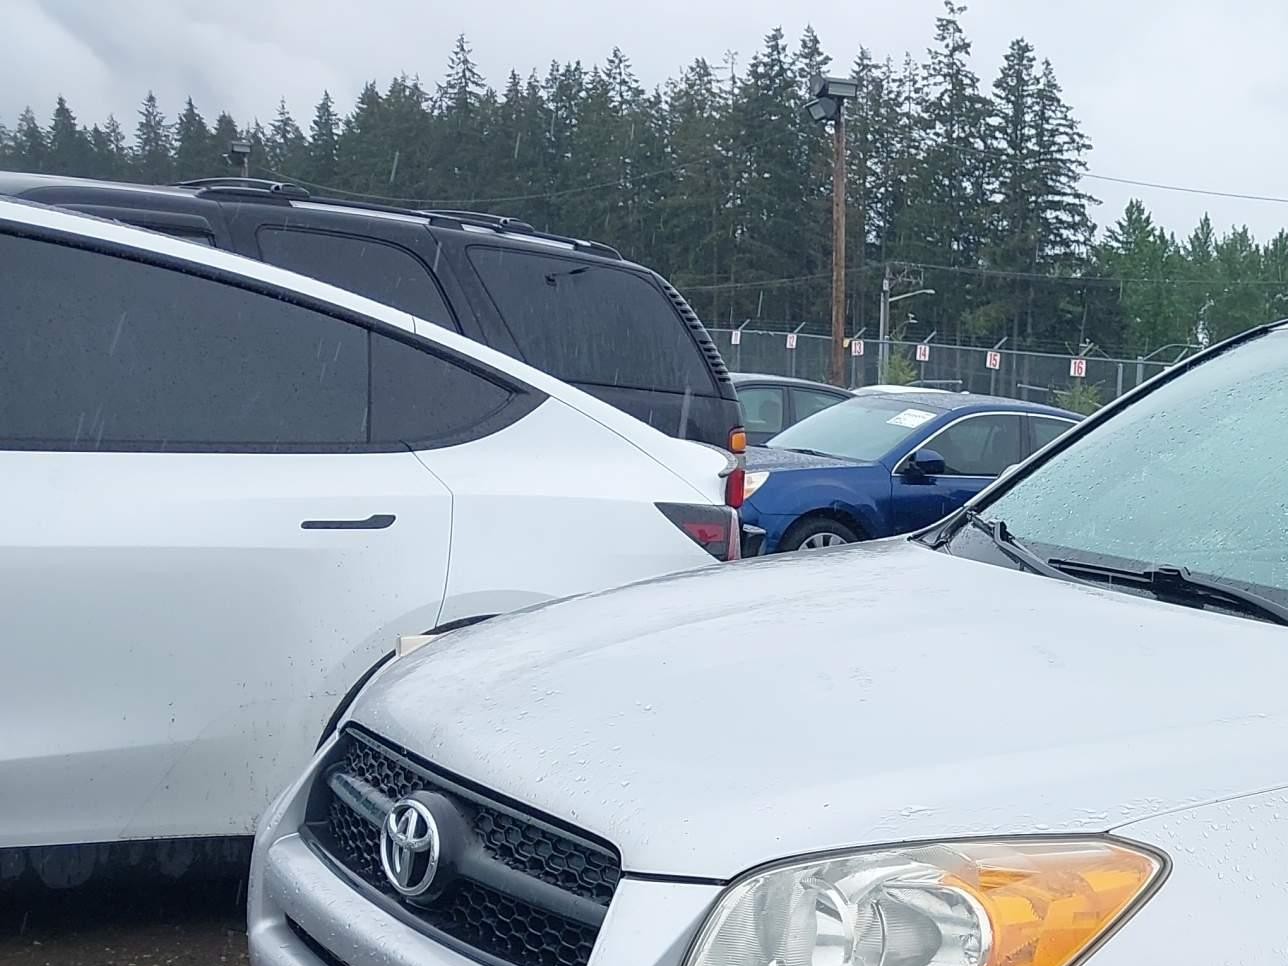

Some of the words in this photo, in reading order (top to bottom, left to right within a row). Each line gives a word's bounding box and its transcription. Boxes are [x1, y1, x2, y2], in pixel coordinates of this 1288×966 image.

[854, 341, 861, 354] 13
[918, 346, 927, 359] 14
[988, 352, 998, 368] 15
[1073, 361, 1083, 376] 16
